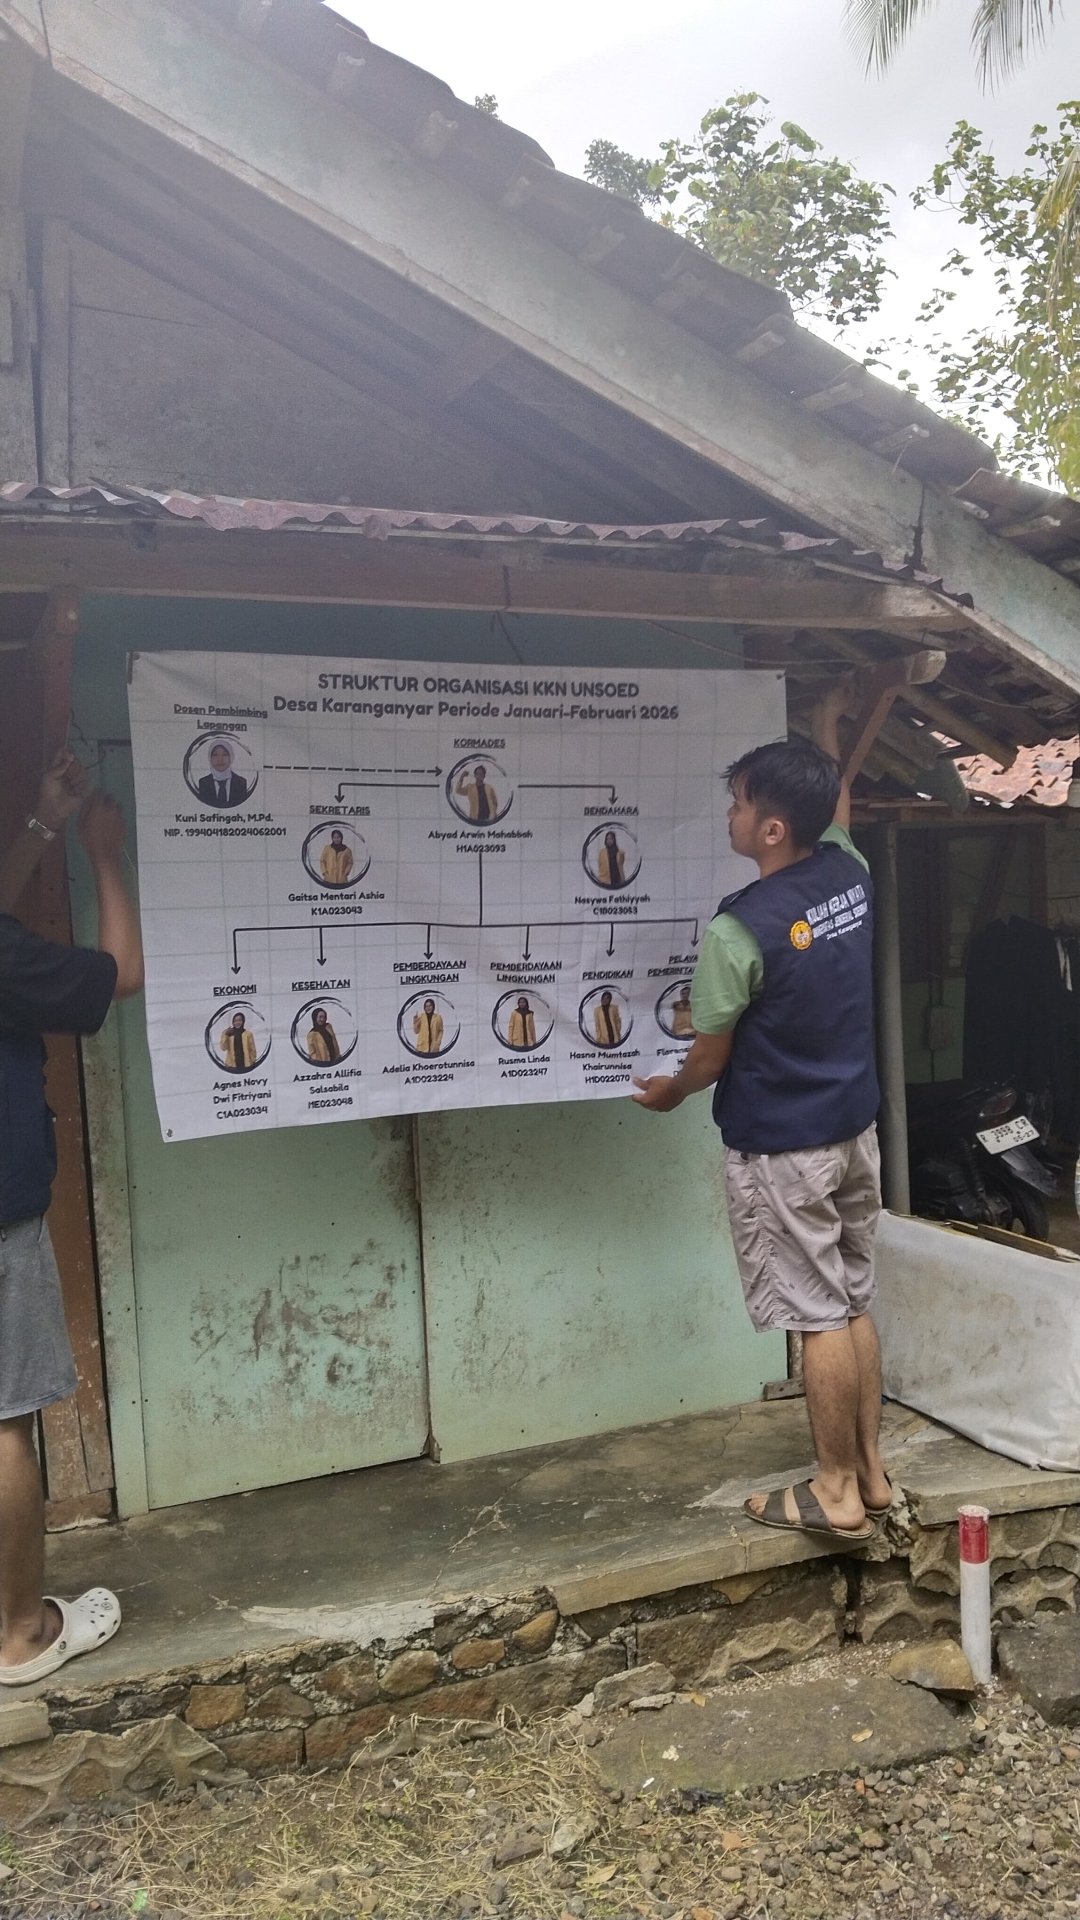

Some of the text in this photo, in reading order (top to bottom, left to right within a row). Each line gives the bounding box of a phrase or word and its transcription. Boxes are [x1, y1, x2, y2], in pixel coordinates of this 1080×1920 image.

[318, 673, 639, 698] STRUKTUR ORGANISASI KKN UNSOED
[174, 704, 268, 719] Dosen Pembimbing
[273, 696, 679, 720] Desa Karanganyar Periode Januari-Februari 2026
[196, 719, 247, 731] Lapangan
[454, 738, 505, 748] KORMADES
[309, 805, 371, 816] SEKRETARIS
[583, 806, 639, 816] BENDAHARA
[175, 813, 274, 824] Kuni Safingah, M.Pd.
[164, 827, 287, 837] NIP. 199404182024062001
[428, 830, 533, 841] Abyad Arwin Mahabbah
[456, 844, 506, 853] H1A023093
[288, 891, 385, 902] Gaitsa Mentari Ashia
[574, 896, 607, 906] Nasywa
[311, 906, 363, 916] K1A023043
[393, 960, 466, 972] PEMBERDAYAAN
[490, 961, 562, 972] PEMBERDAYAAN
[400, 973, 459, 985] LINGKUNGAN
[496, 973, 556, 984] LINGKUNGAN
[582, 969, 634, 980] PENDIDIKAN
[213, 984, 257, 996] EKONOMI
[291, 979, 351, 992] KESEHATAN
[570, 1048, 640, 1060] Hasna Mumtazah
[498, 1055, 551, 1066] Rusma Linda
[382, 1065, 411, 1074] Adelia
[582, 1062, 632, 1071] Khairunnisa
[293, 1071, 332, 1083] Azzahra
[501, 1067, 548, 1079] A1D023247
[213, 1077, 268, 1092] Agnes Novy
[404, 1073, 454, 1085] A1D023224
[585, 1074, 631, 1084] H1D022070
[309, 1083, 350, 1095] Salsabila
[213, 1089, 272, 1105] Dwi Fitriyani
[216, 1105, 268, 1119] C1A023034
